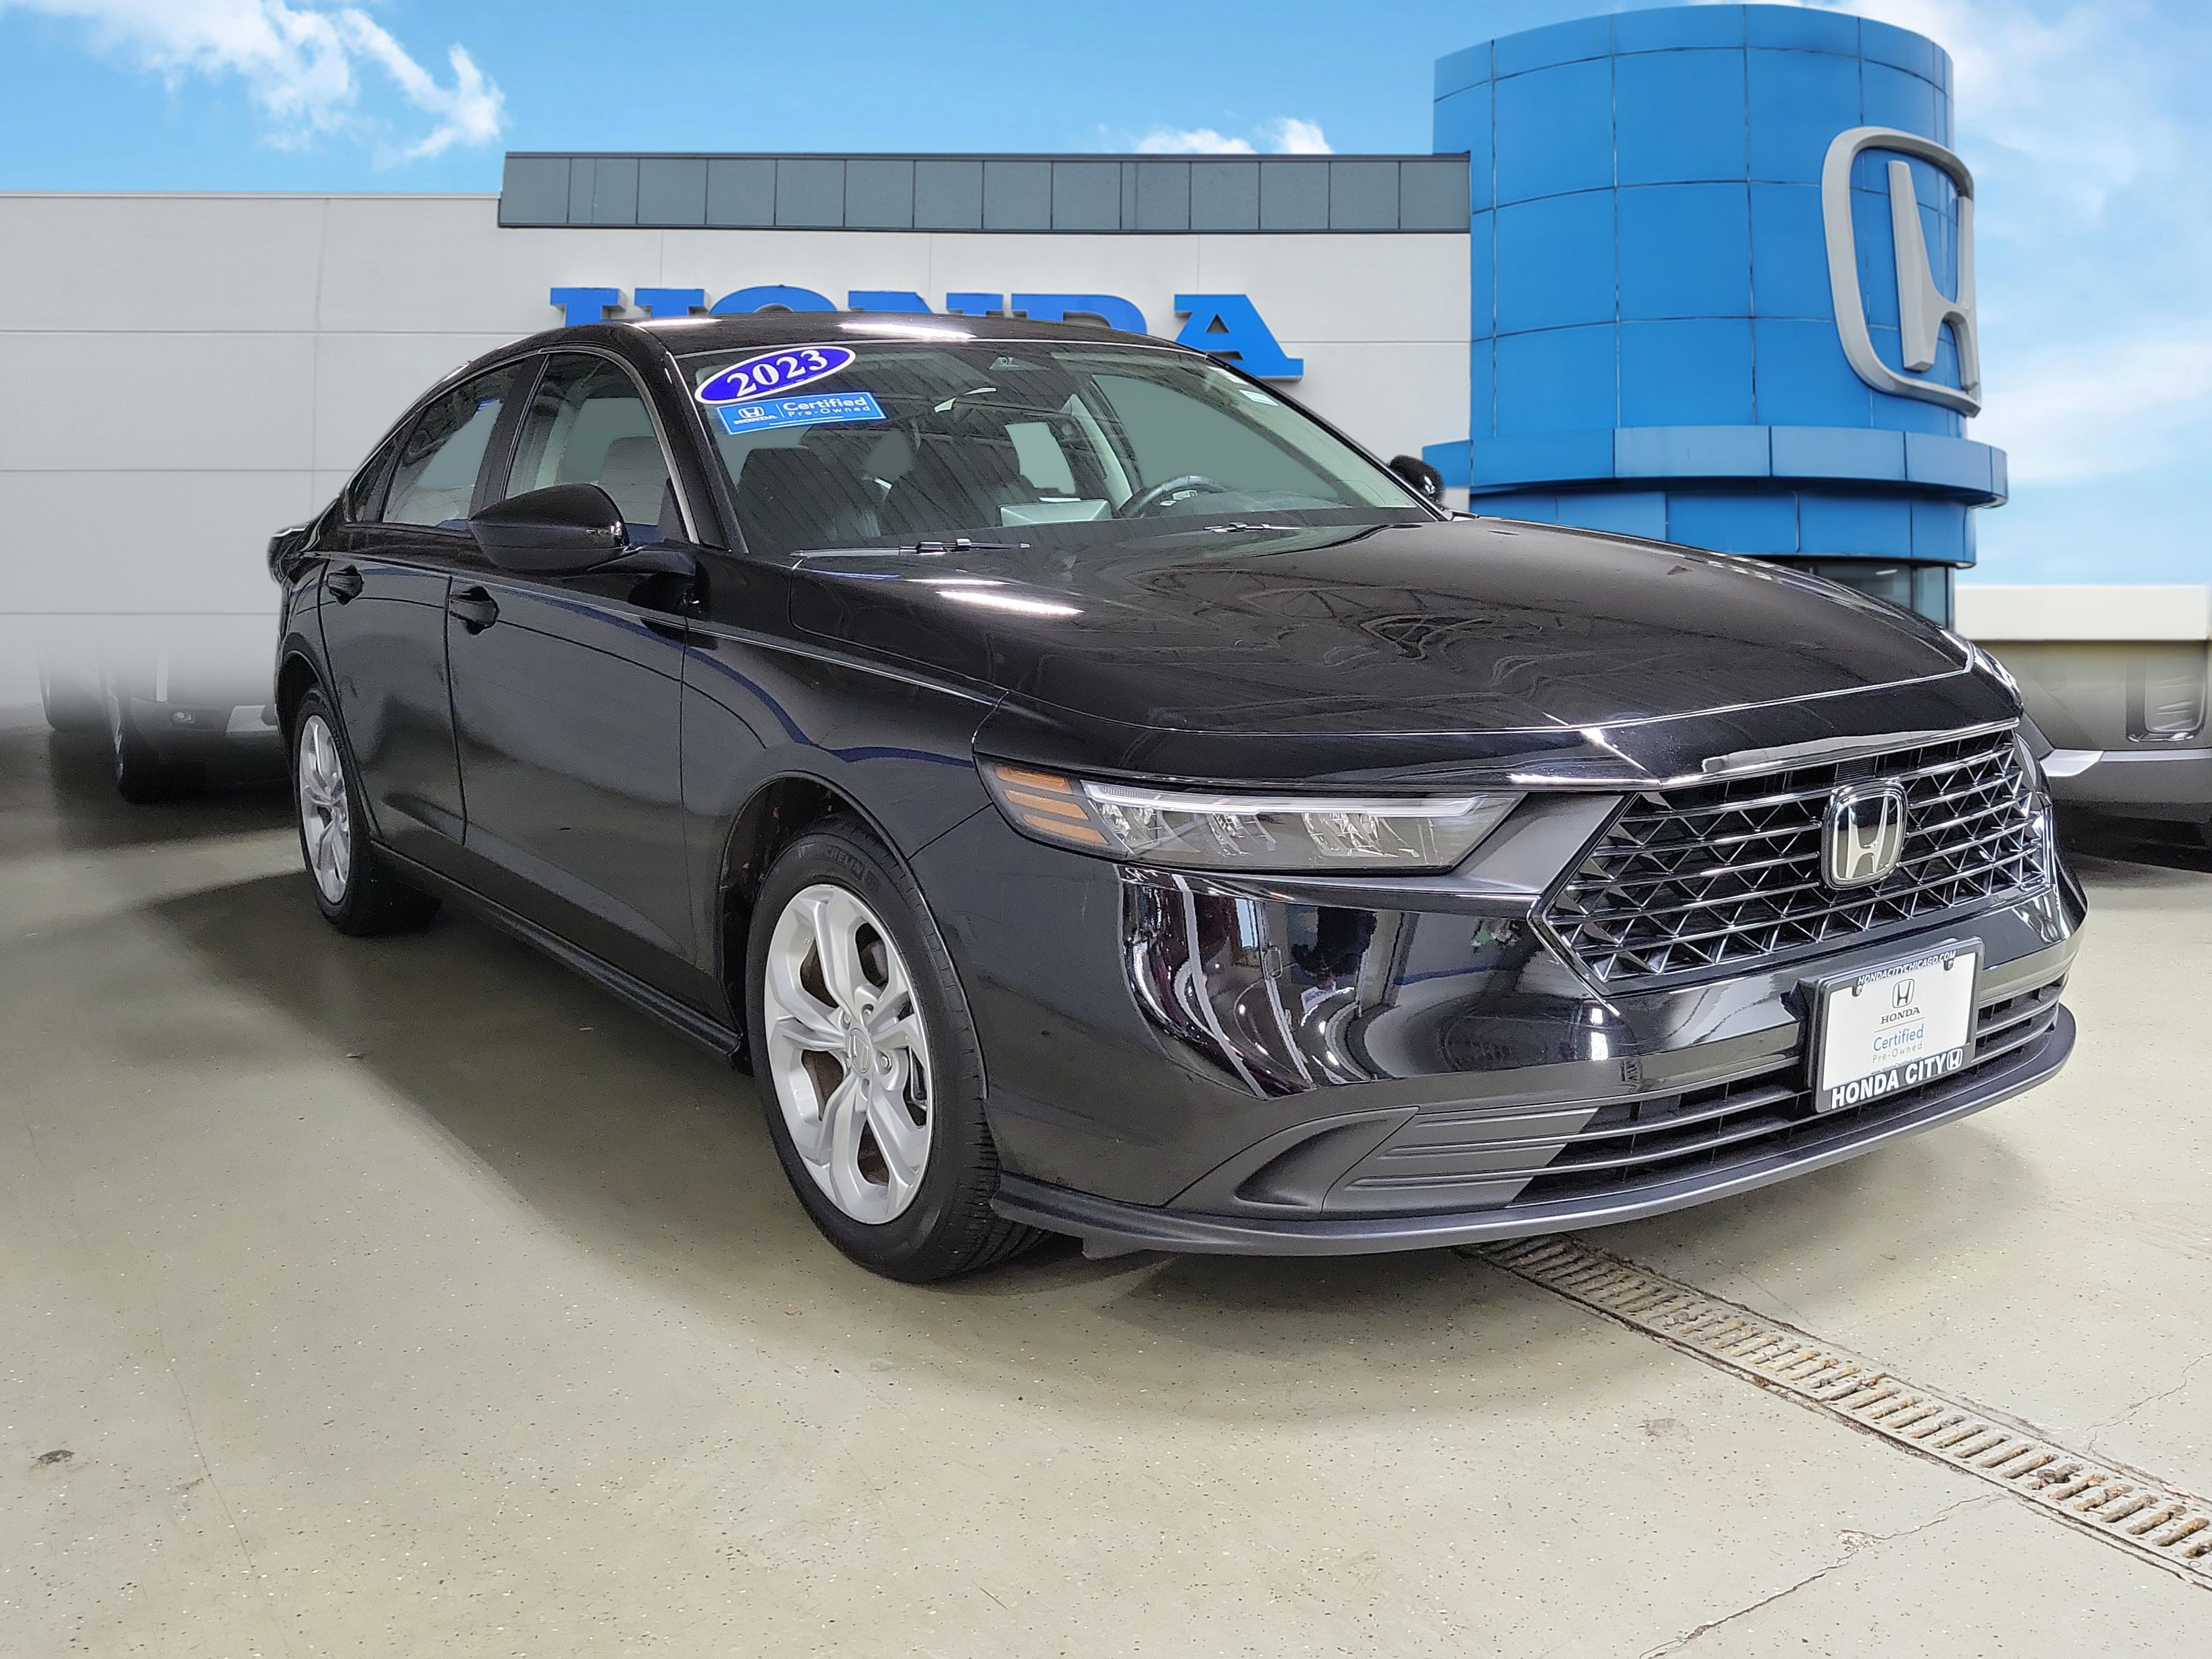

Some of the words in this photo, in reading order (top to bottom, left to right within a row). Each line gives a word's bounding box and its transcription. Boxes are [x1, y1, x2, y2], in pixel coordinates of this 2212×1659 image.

[727, 349, 828, 397] 2023
[782, 397, 868, 411] Certified
[787, 405, 871, 418] Pre-Owned
[733, 415, 778, 425] HONDA
[1857, 950, 1956, 985] HONDACITYCHICAGO.COM
[1880, 1007, 1920, 1025] HONDA
[1873, 1023, 1925, 1052] Certified
[1872, 1042, 1923, 1064] Pre-Owned
[1831, 1069, 1899, 1109] HONDA
[1905, 1053, 1948, 1084] CITY
